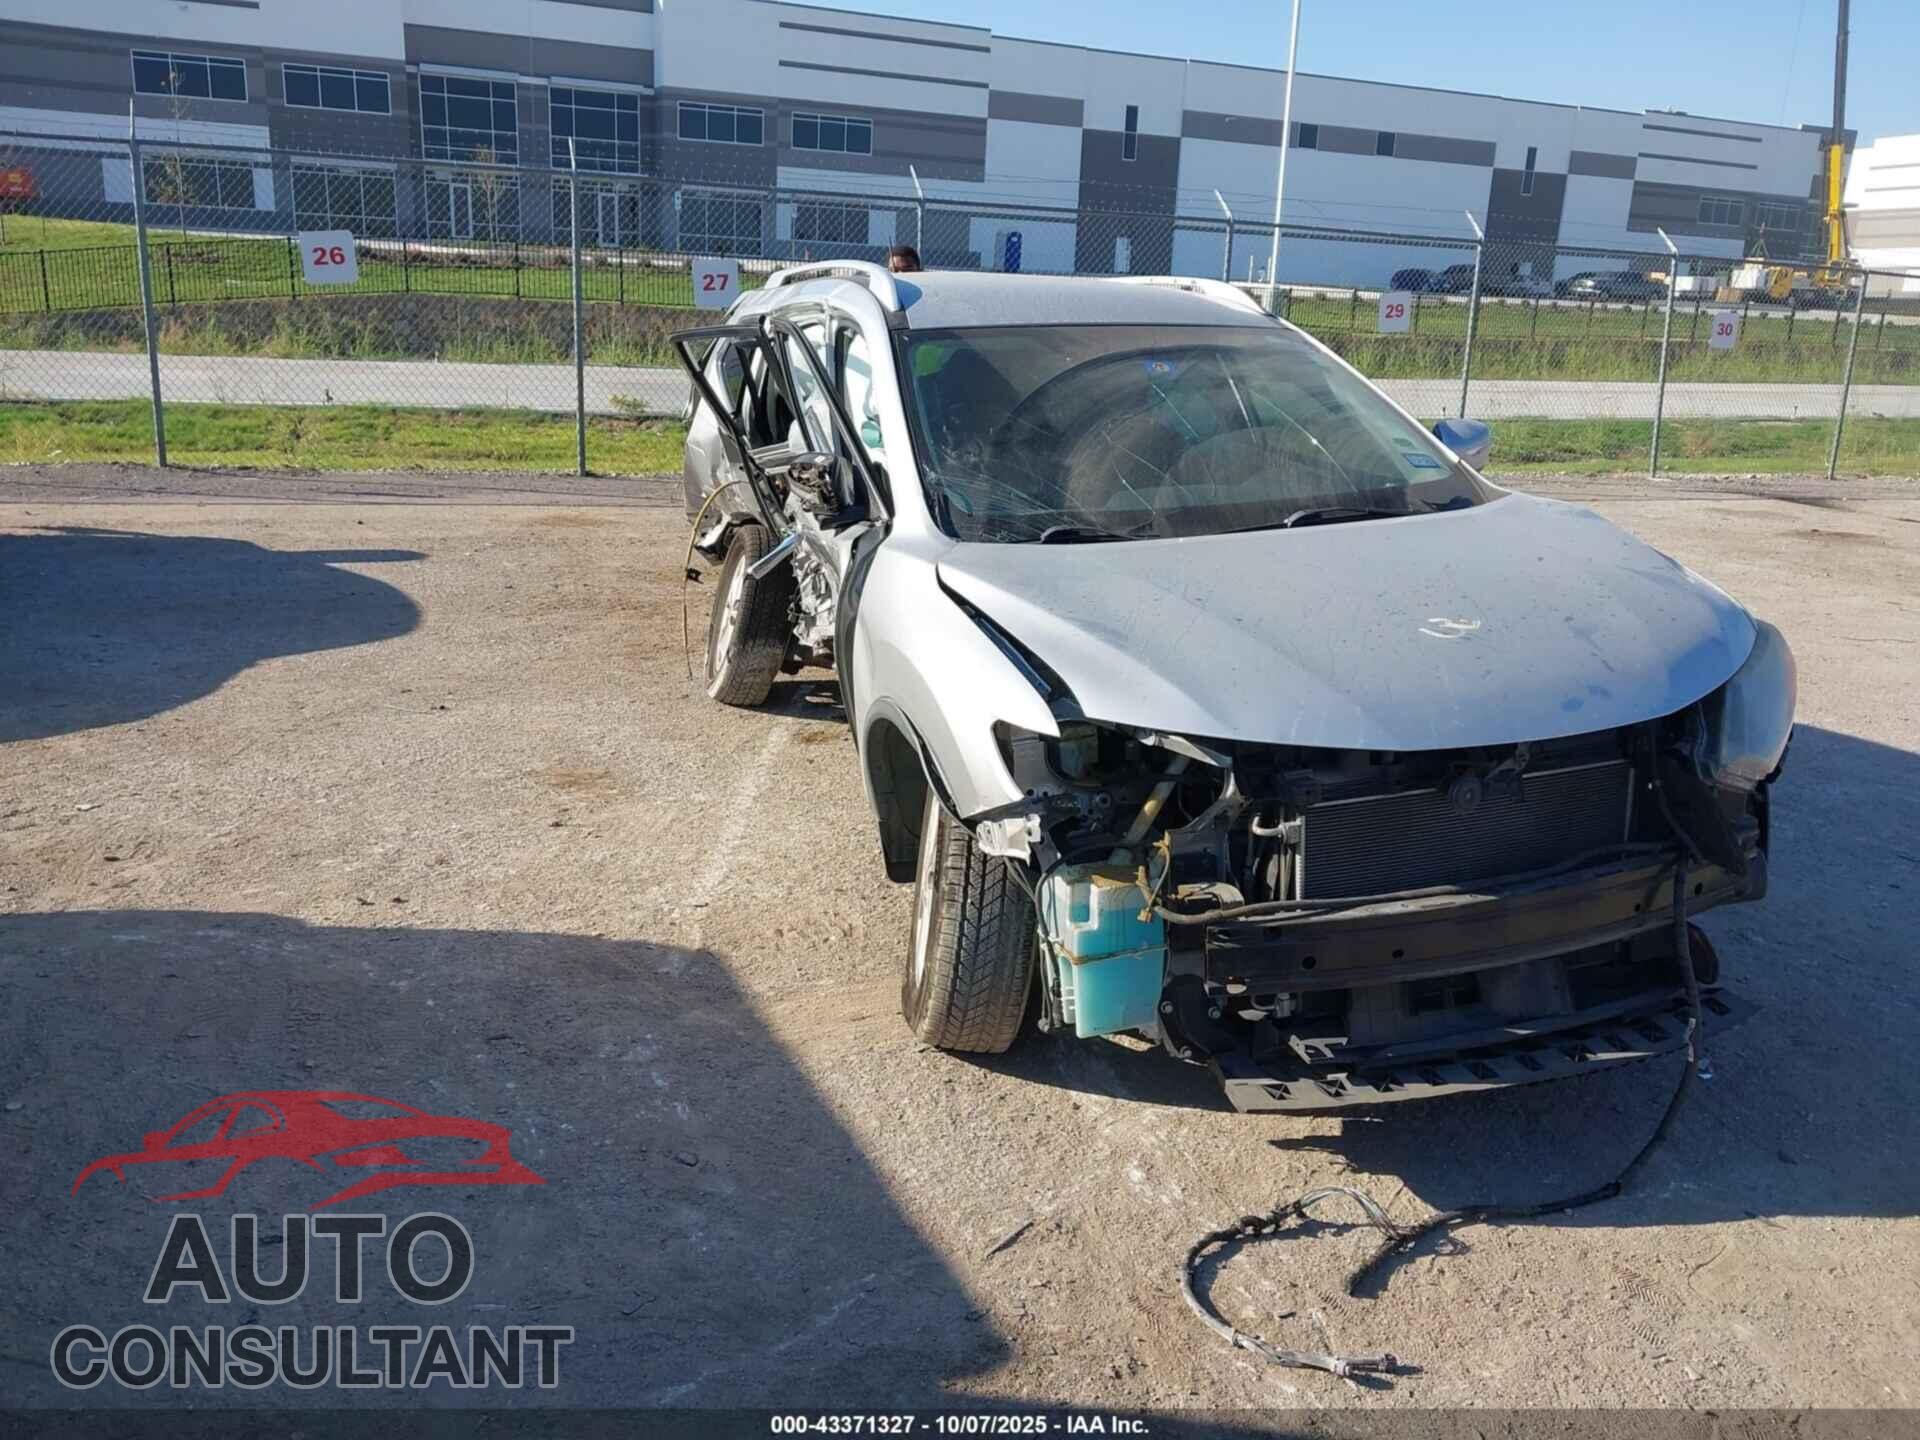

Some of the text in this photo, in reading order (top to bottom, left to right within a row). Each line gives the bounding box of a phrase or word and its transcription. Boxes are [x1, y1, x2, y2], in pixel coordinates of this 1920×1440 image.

[312, 246, 346, 266] 26
[703, 273, 729, 291] 27
[1385, 303, 1404, 319] 29
[1717, 322, 1733, 337] 30
